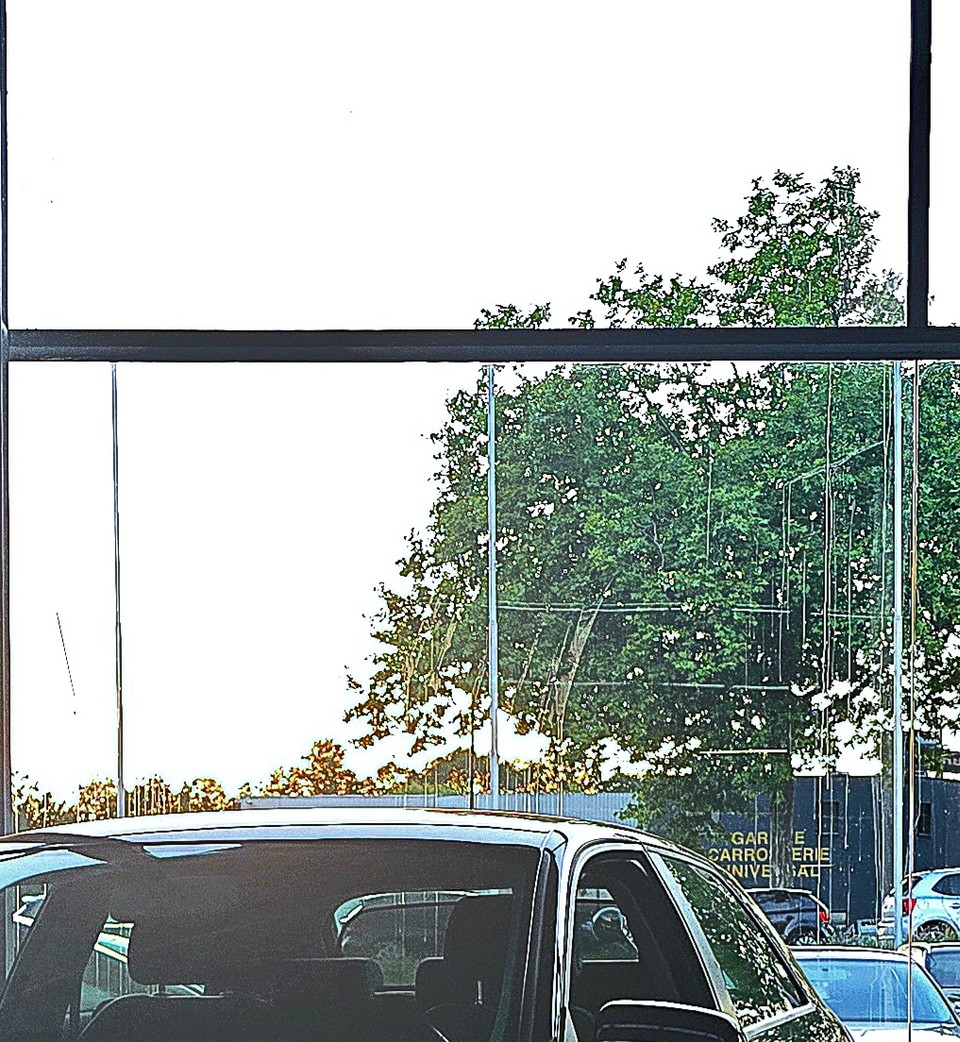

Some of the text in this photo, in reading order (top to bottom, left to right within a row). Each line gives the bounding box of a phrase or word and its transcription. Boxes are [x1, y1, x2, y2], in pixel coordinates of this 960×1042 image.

[731, 831, 806, 845] GARE
[708, 847, 831, 862] CARROERIE
[724, 864, 819, 878] NIVEAL
